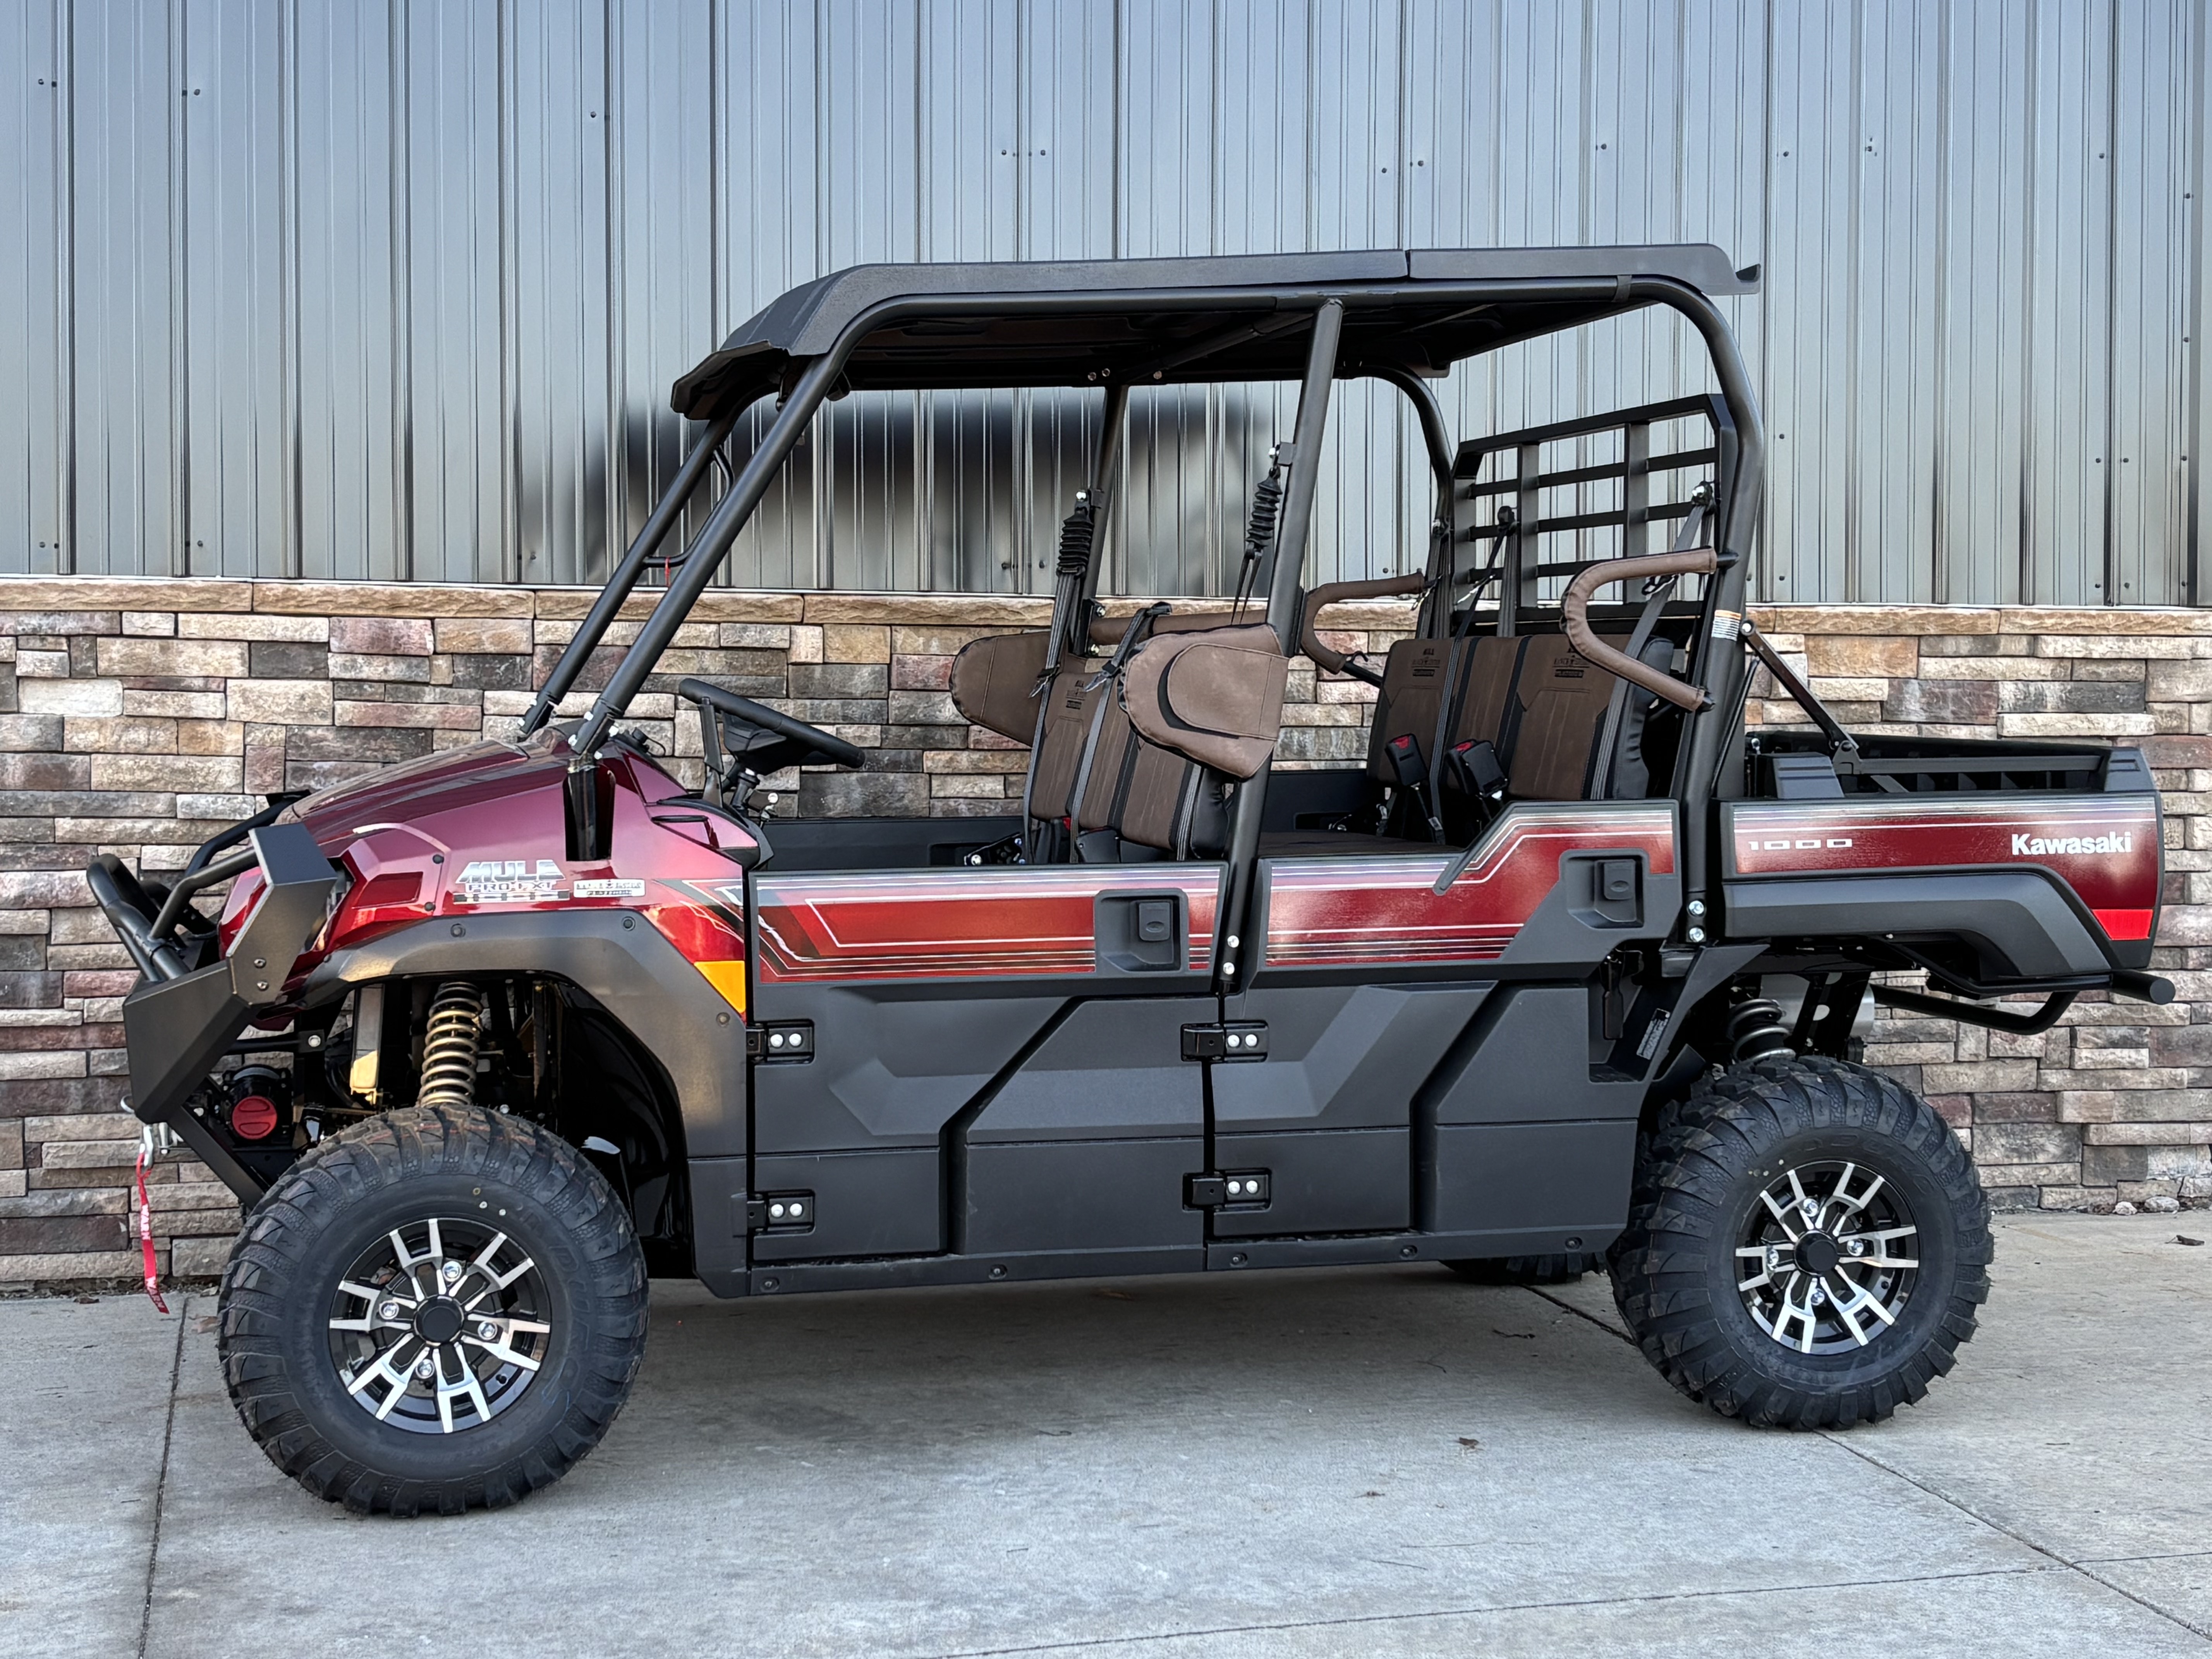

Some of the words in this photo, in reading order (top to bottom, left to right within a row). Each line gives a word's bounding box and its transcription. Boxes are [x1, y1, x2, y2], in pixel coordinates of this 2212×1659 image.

[1748, 838, 1853, 851] 1000
[2011, 831, 2131, 855] Kawasaki
[455, 859, 566, 884] MULE
[141, 1204, 151, 1240] WARN
[145, 1276, 165, 1309] WARN
